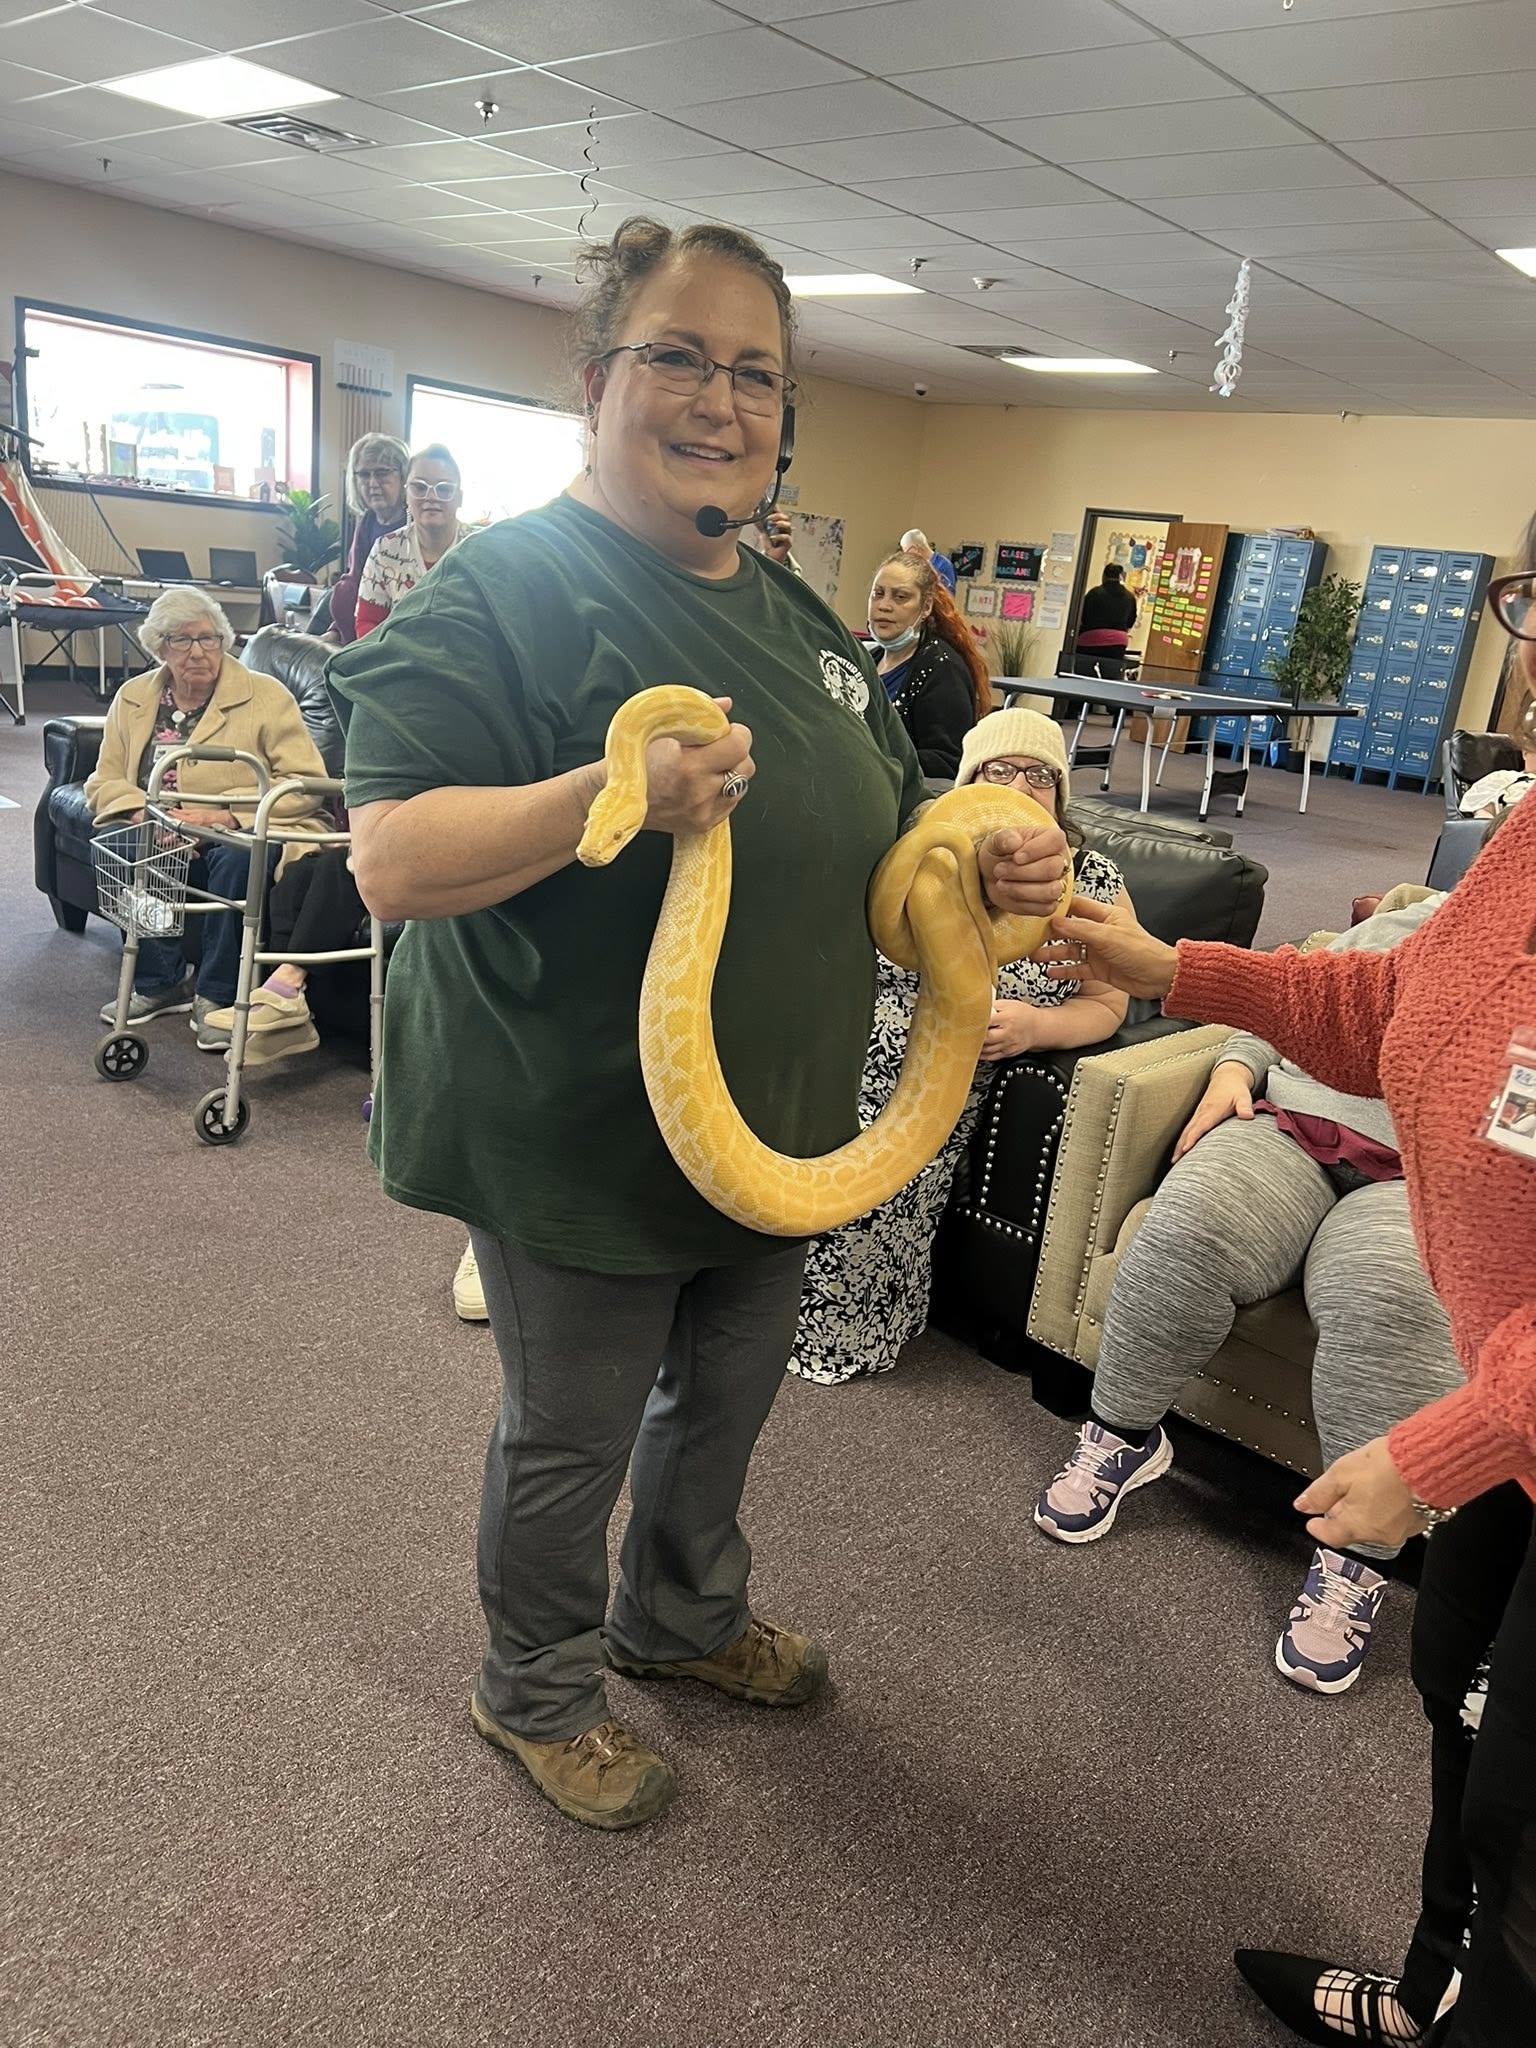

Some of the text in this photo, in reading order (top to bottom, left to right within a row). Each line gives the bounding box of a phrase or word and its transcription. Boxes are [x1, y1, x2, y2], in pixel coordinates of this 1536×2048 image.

[1001, 549, 1030, 560] CLASES
[1373, 635, 1384, 644] 25
[1408, 640, 1418, 649] 26
[1444, 646, 1455, 654] 27
[1366, 672, 1376, 681] 28
[1401, 676, 1411, 684] 29
[1436, 681, 1447, 689] 30
[1393, 712, 1403, 720] 32
[1428, 716, 1439, 725] 33
[1227, 720, 1236, 728] 17
[1350, 740, 1360, 749] 34
[1384, 746, 1394, 755] 35
[1418, 751, 1429, 760] 36
